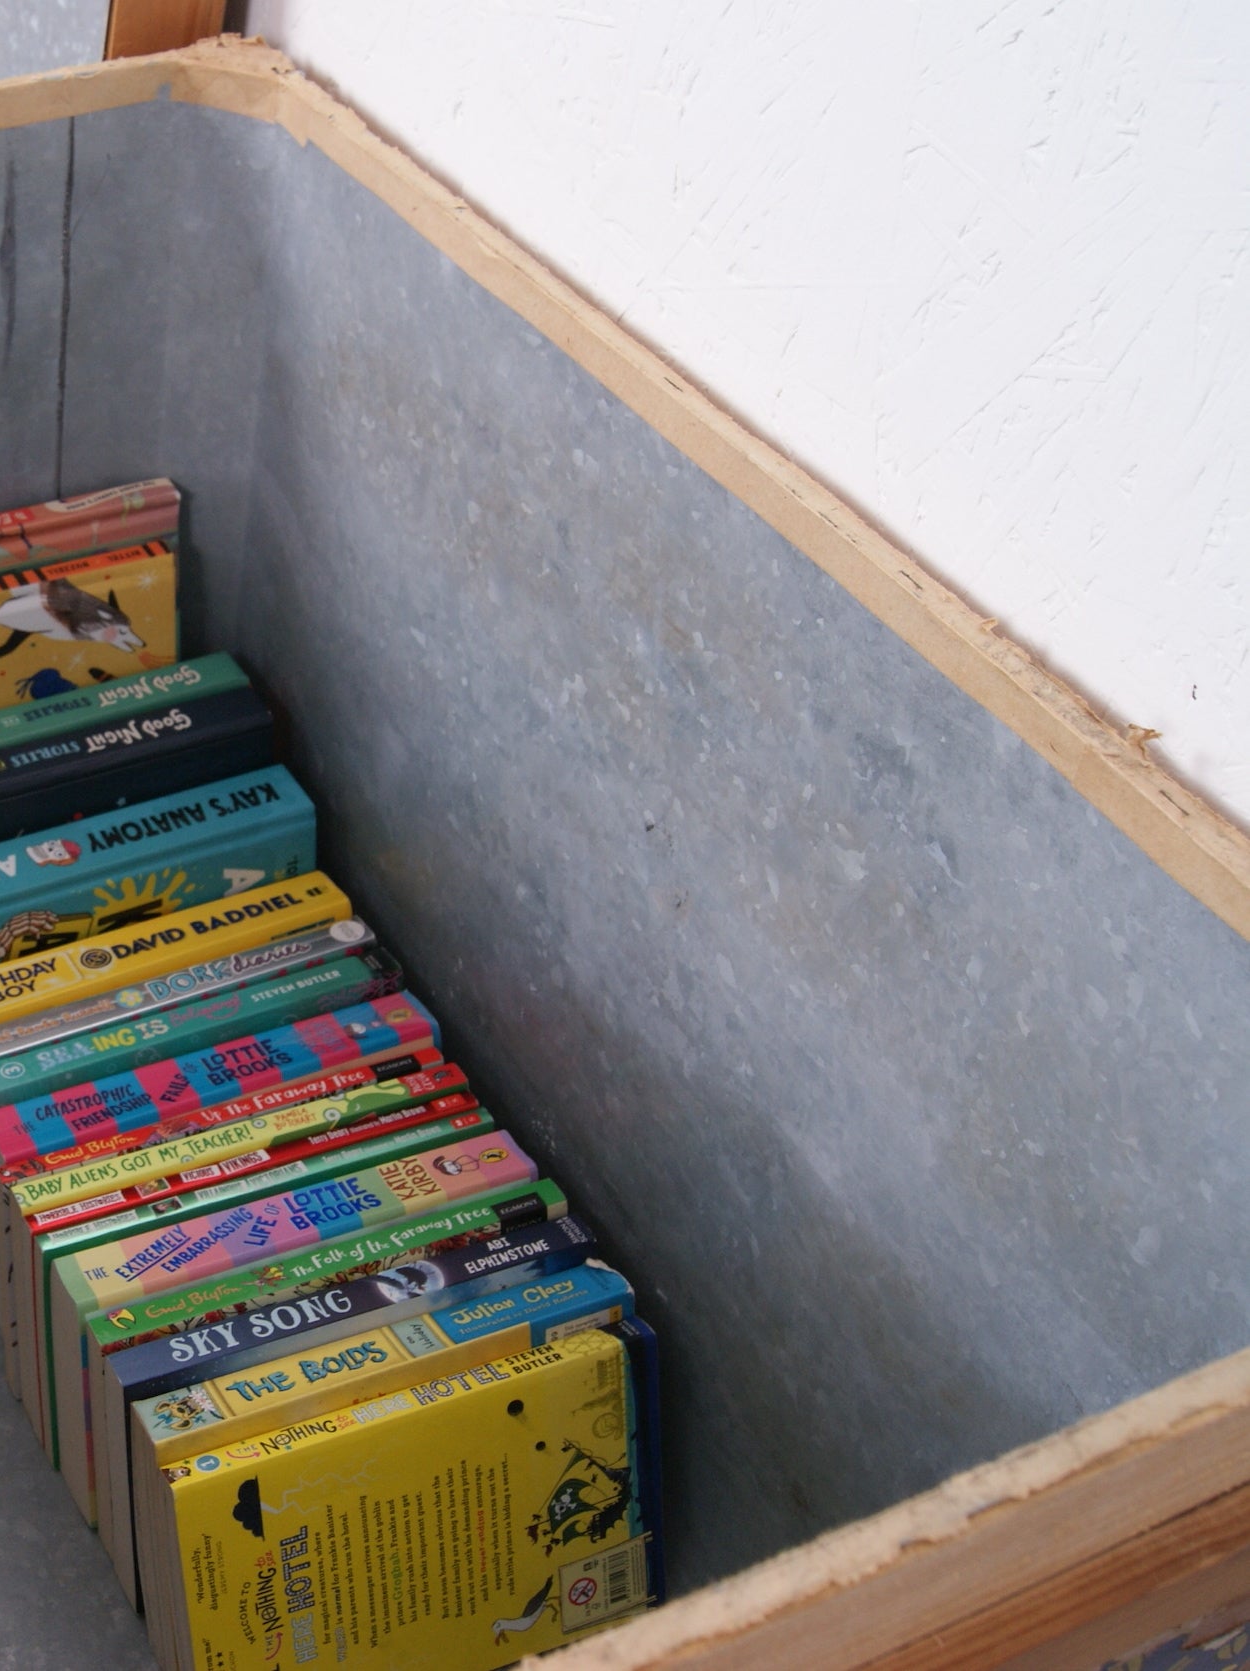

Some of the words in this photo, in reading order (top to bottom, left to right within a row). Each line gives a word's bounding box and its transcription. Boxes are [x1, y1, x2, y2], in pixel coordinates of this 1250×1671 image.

[10, 740, 80, 766] STORIES
[208, 783, 279, 817] KAY'S
[87, 804, 205, 850] ANATOMY
[112, 927, 185, 958] DAVID
[190, 892, 301, 933] BADDIEL
[145, 961, 230, 999] DORK
[231, 940, 310, 971] diaries
[251, 983, 296, 1002] STEVEN
[298, 970, 340, 988] BUTLER
[135, 1019, 168, 1039] IS
[202, 1040, 275, 1071] LOTTIE
[208, 1053, 291, 1085] BROOKS
[35, 1082, 132, 1120] CATASTROPHIC
[159, 1067, 190, 1104] FAILS
[254, 1079, 327, 1110] Faraway
[328, 1069, 364, 1087] Tree
[12, 1120, 36, 1136] THE
[72, 1094, 152, 1129] FRIENDSHIP
[273, 1107, 306, 1121] PAMELA
[25, 1178, 62, 1200] BABY
[66, 1162, 118, 1188] ALIENS
[121, 1152, 151, 1172] GOT
[156, 1143, 180, 1162] MY
[183, 1124, 253, 1155] TEACHER!
[45, 1146, 83, 1164] Enid
[87, 1131, 137, 1153] Blyton
[183, 1167, 214, 1182] VICIOUS
[223, 1151, 265, 1172] VIKINGS
[380, 1162, 418, 1201] KATIE
[397, 1157, 441, 1197] KIRBY
[39, 1205, 76, 1222] HORRIBLE
[79, 1192, 122, 1211] HISTORIES
[284, 1178, 364, 1213] LOTTIE
[292, 1194, 380, 1230] BROOKS
[498, 1198, 537, 1216] EGMONT
[161, 1205, 255, 1272] EMBARRASSING
[242, 1214, 269, 1249] LIFE
[290, 1262, 314, 1278] The
[312, 1248, 347, 1269] Folk
[347, 1243, 368, 1261] of
[366, 1235, 390, 1254] the
[390, 1217, 454, 1248] Faraway
[454, 1205, 489, 1225] Tree
[486, 1236, 511, 1252] ABI
[115, 1225, 189, 1278] EXTREMELY
[464, 1239, 550, 1275] ELPHINSTONE
[84, 1265, 108, 1281] THE
[144, 1298, 186, 1320] Enid
[187, 1282, 239, 1308] Blyton
[453, 1299, 515, 1325] Julian
[521, 1279, 574, 1304] Clary
[459, 1313, 511, 1335] Illustrated
[525, 1301, 549, 1315] David
[553, 1290, 589, 1306] Roberts
[167, 1323, 239, 1361] SKY
[248, 1290, 351, 1337] SONG
[226, 1368, 296, 1404] THE
[299, 1340, 387, 1383] BOLDS
[505, 1344, 553, 1366] STEVEN
[513, 1352, 562, 1374] BUTLER
[352, 1392, 412, 1423] HERE
[411, 1360, 509, 1405] HOTEL
[236, 1443, 258, 1455] THE
[260, 1416, 335, 1453] NOTHING
[325, 1504, 335, 1538] Banister
[358, 1495, 371, 1543] announcing
[371, 1501, 384, 1527] goblin
[434, 1508, 444, 1540] obvious
[460, 1488, 472, 1531] demanding
[313, 1531, 323, 1556] where
[387, 1516, 397, 1547] Frankie
[415, 1517, 428, 1558] important
[450, 1520, 460, 1542] going
[253, 1556, 265, 1568] to
[265, 1550, 276, 1566] see
[280, 1525, 315, 1613] HOTEL
[329, 1540, 339, 1571] Frankie
[451, 1559, 462, 1583] family
[206, 1560, 219, 1610] disgustingly
[239, 1580, 252, 1594] TO
[251, 1567, 284, 1633] NOTHING
[332, 1586, 342, 1615] normal
[347, 1585, 358, 1615] parents
[379, 1582, 389, 1618] imminent
[407, 1583, 418, 1607] family
[238, 1597, 256, 1644] WELCOME
[320, 1600, 330, 1630] magical
[264, 1634, 275, 1651] THE
[291, 1612, 318, 1664] HERE
